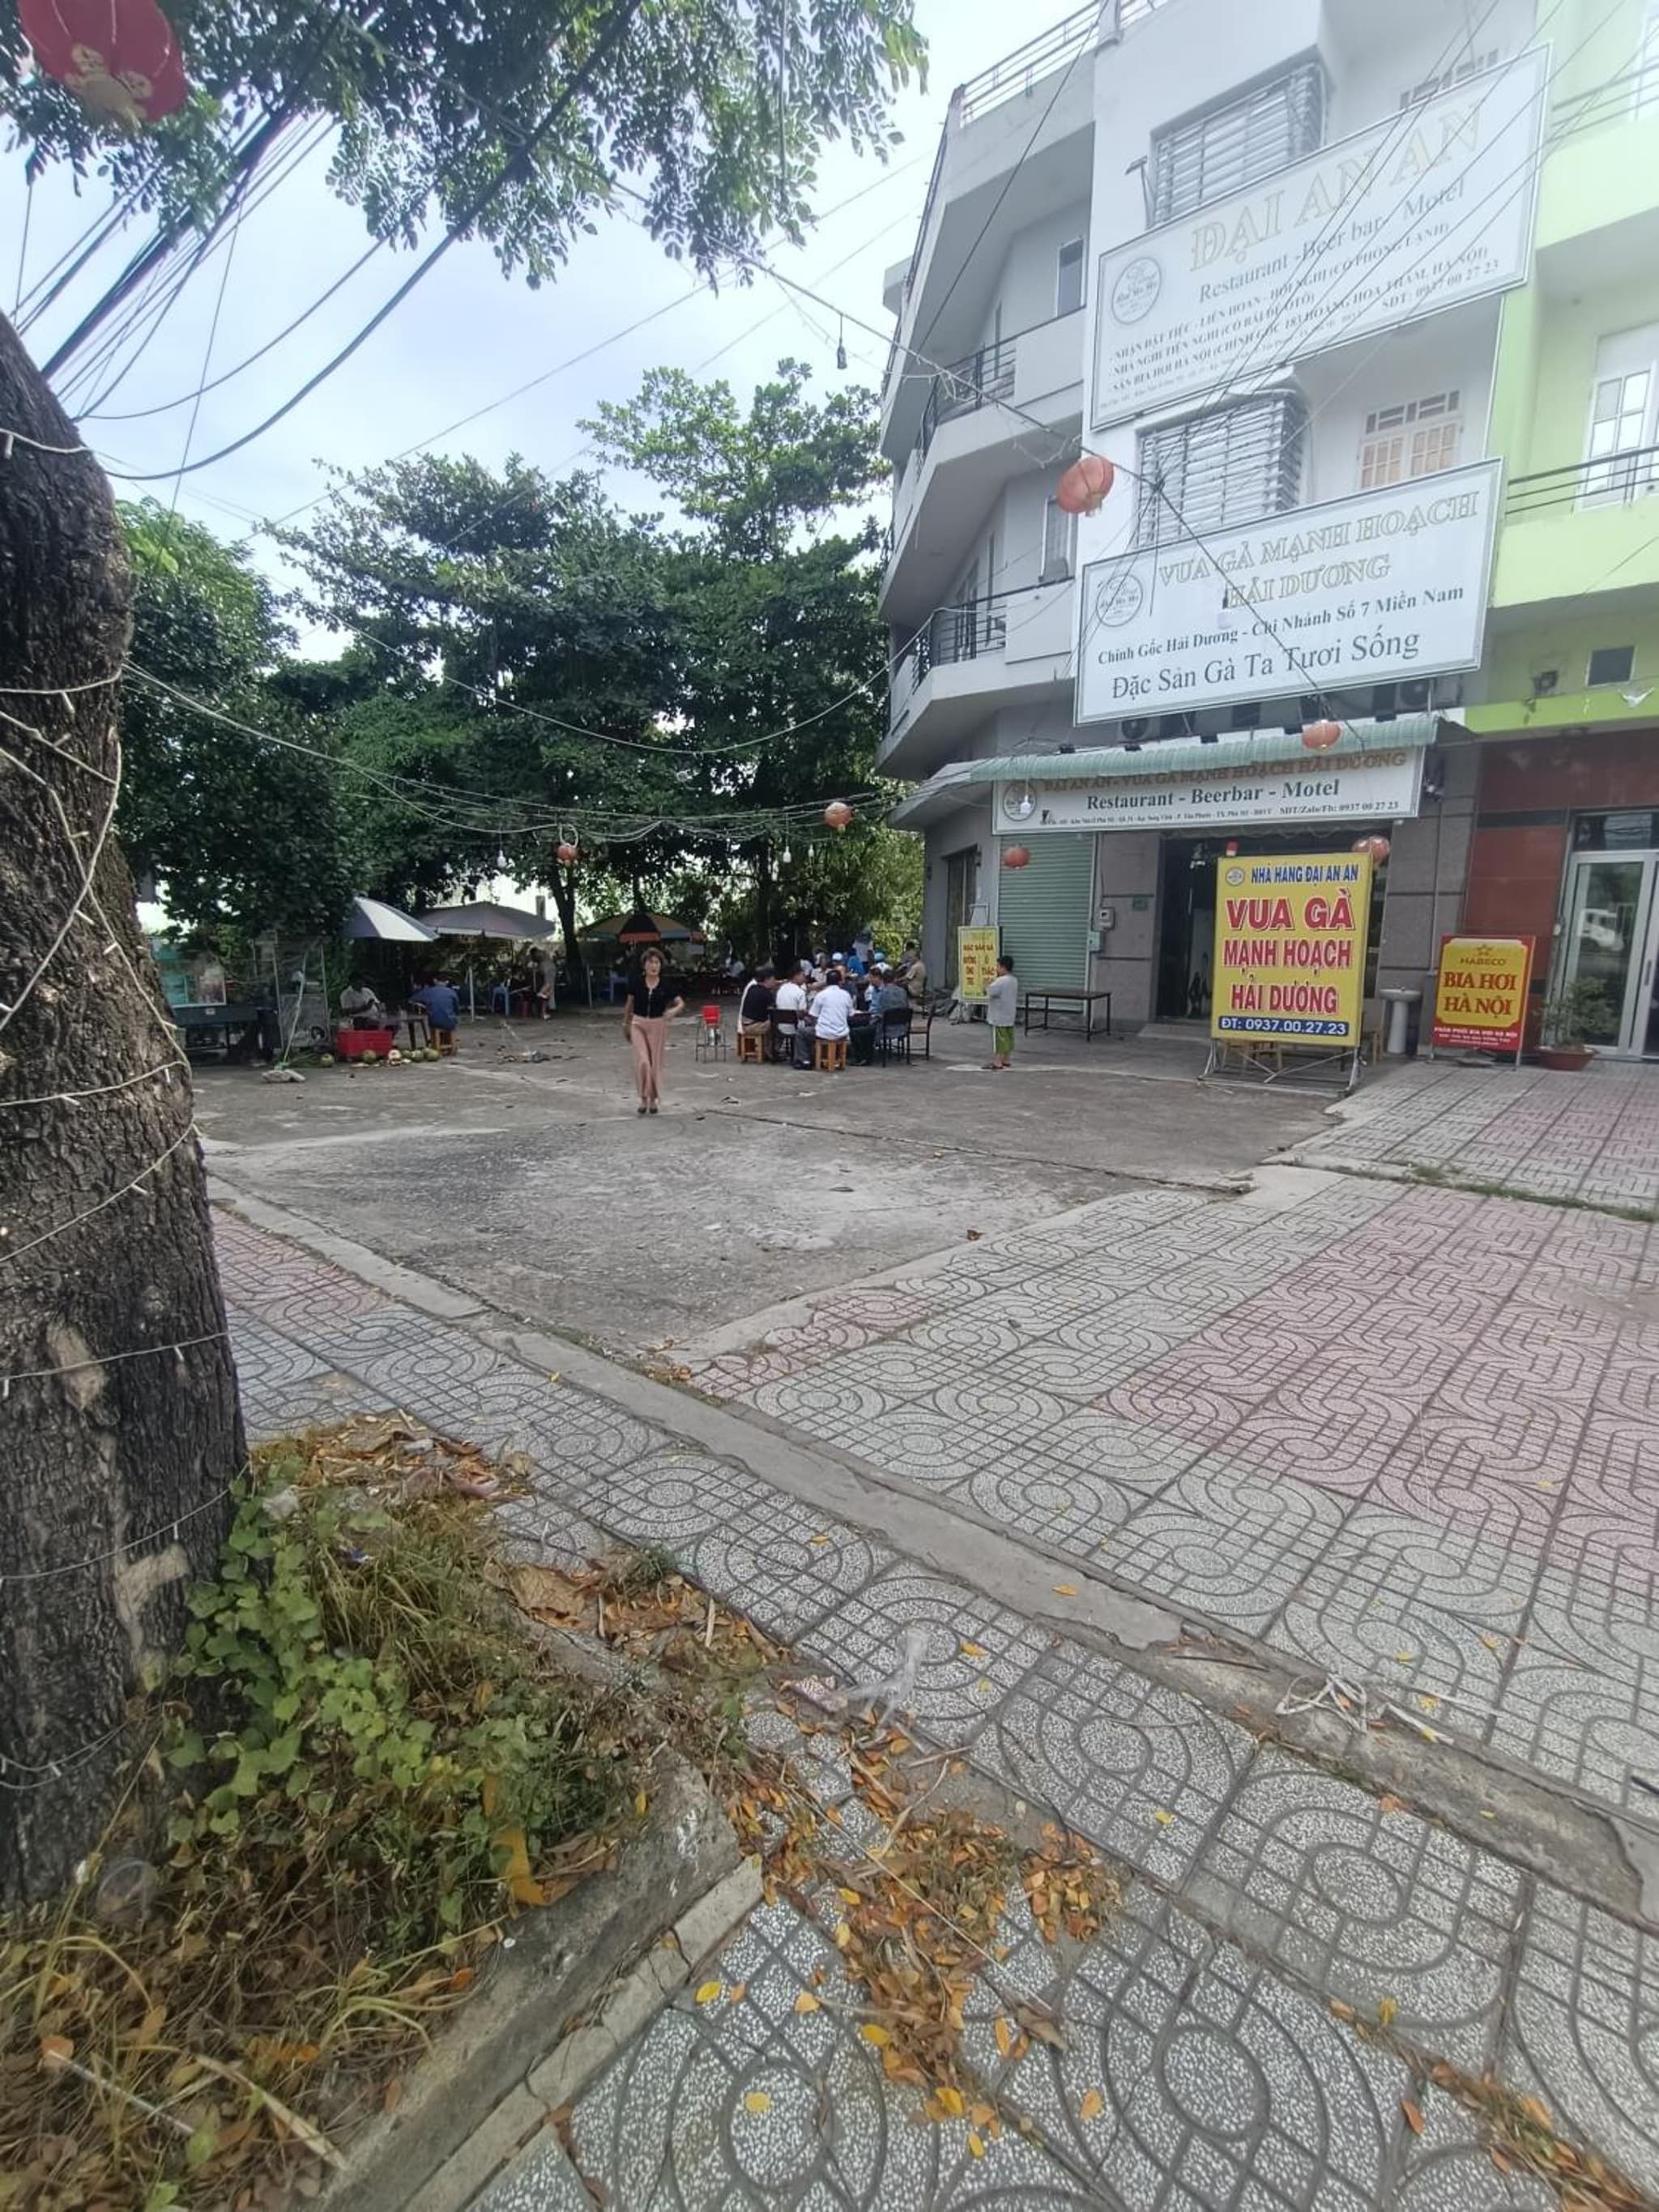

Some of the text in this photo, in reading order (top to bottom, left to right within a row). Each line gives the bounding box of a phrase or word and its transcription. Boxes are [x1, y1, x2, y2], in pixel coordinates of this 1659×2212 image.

[1294, 147, 1380, 228] AN
[1389, 103, 1482, 186] AN
[1200, 254, 1288, 302] Restaurant
[1403, 177, 1465, 219] Motel
[1260, 522, 1352, 565] MẠNH
[1356, 491, 1479, 543] HOẠCH
[1278, 554, 1391, 599] DƯƠNG
[1098, 647, 1134, 665] Chính
[1138, 638, 1162, 658] Gốc
[1166, 636, 1189, 653] Hải
[1193, 629, 1238, 648] Dương
[1252, 619, 1277, 637] Chi
[1282, 609, 1331, 632] Nhánh
[1336, 599, 1356, 621] Số
[1361, 602, 1370, 617] 7
[1375, 590, 1416, 613] Miền
[1422, 586, 1464, 605] Nam
[1112, 624, 1421, 701] Đặc Sản Gà Ta Tươi Sống
[1088, 792, 1173, 810] Restaurant
[1192, 786, 1263, 804] Beerbar
[1282, 778, 1339, 799] Motel
[1252, 862, 1358, 886] NHÀ HÀNG ĐẠI AN AN
[1226, 888, 1354, 930] VUA GÀ
[1223, 939, 1351, 974] MẠNH HOẠCH
[1460, 957, 1506, 966] HABECO
[1230, 974, 1337, 1013] HẢI DƯƠNG
[1444, 971, 1517, 990] BIA HƠI
[1444, 992, 1512, 1018] HÀ NỘI
[1221, 1018, 1346, 1034] ĐT: 0937.00.27.23
